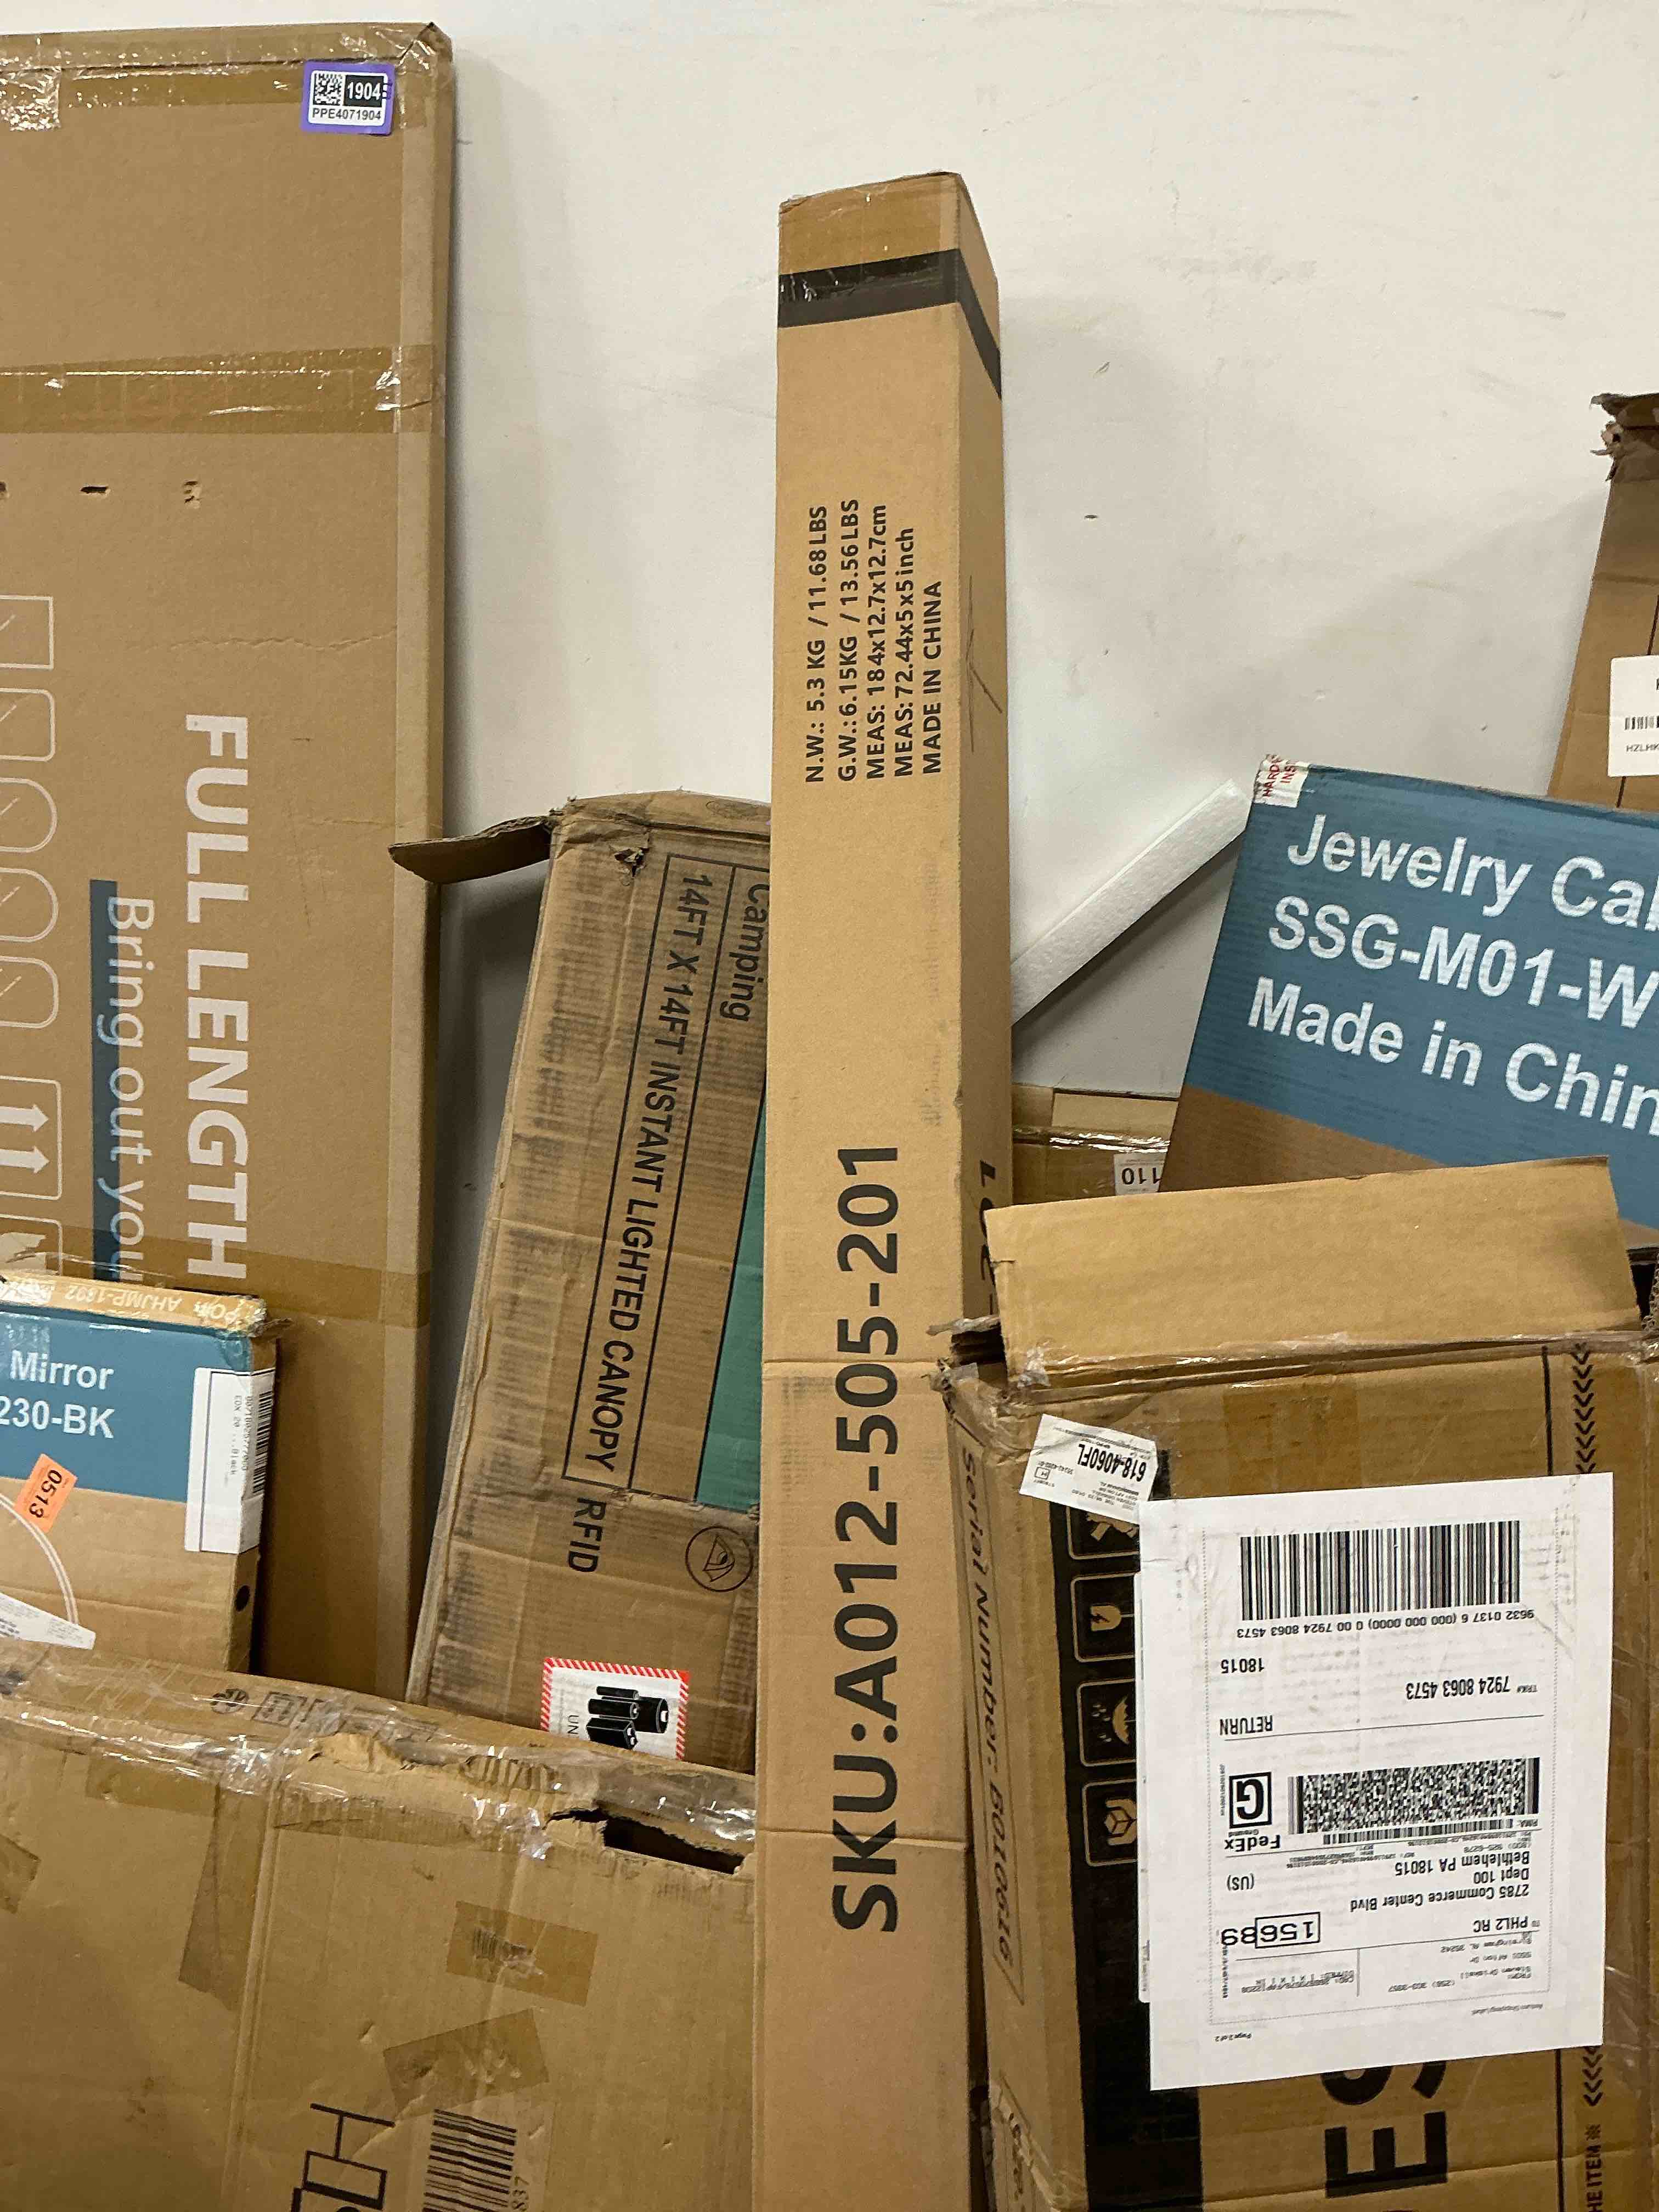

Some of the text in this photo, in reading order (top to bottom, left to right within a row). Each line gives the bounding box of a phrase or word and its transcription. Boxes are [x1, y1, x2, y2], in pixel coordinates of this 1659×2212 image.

[347, 82, 381, 100] 1904
[312, 108, 381, 121] PPE4071904
[866, 505, 886, 779] MEAS: 184x12.7x12.7cm
[807, 639, 825, 669] KG
[923, 581, 941, 774] MADE IN CHINA
[806, 677, 825, 711] 5.3
[1287, 813, 1533, 918] Jewelry
[719, 883, 770, 1023] Camping
[1268, 895, 1659, 1029] SSG-M01-W
[97, 895, 155, 1048] Bring
[185, 714, 249, 1279] FULL LENGTH
[1248, 976, 1404, 1064] Made
[1421, 1019, 1483, 1087] in
[110, 1066, 152, 1165] out
[585, 873, 712, 1473] 14FT X 14FT INSTANT LIGHTED CANOPY
[9, 1350, 115, 1390] Mirror
[28, 1469, 63, 1519] 0513
[567, 1497, 607, 1574] RFID
[831, 1147, 899, 1932] SKU:A012-505-201
[1405, 1616, 1427, 1627] 000
[1461, 1613, 1469, 1624] 6
[1472, 1611, 1502, 1623] 0137
[1505, 1609, 1535, 1621] 9632
[1236, 1628, 1267, 1638] 4573
[1271, 1625, 1300, 1637] 8063
[1303, 1623, 1333, 1634] 7924
[1337, 1622, 1352, 1632] 00
[1220, 1657, 1265, 1674] 18015
[1405, 1682, 1438, 1700] 4573
[1442, 1679, 1475, 1698] 8063
[1478, 1676, 1511, 1695] 7924
[1219, 1715, 1273, 1736] RETURN
[1235, 1778, 1265, 1820] G
[1223, 1833, 1281, 1853] FedEx
[1395, 1850, 1531, 1876] Bethlehem PA 18015
[1227, 1872, 1255, 1891] (US)
[1472, 1866, 1530, 1884] Dept 100
[1350, 1883, 1530, 1913] 2785 Commerce Center Blvd
[1220, 1921, 1314, 1946] 15689
[1472, 1919, 1491, 1933] RC
[1495, 1915, 1529, 1931] PHL2
